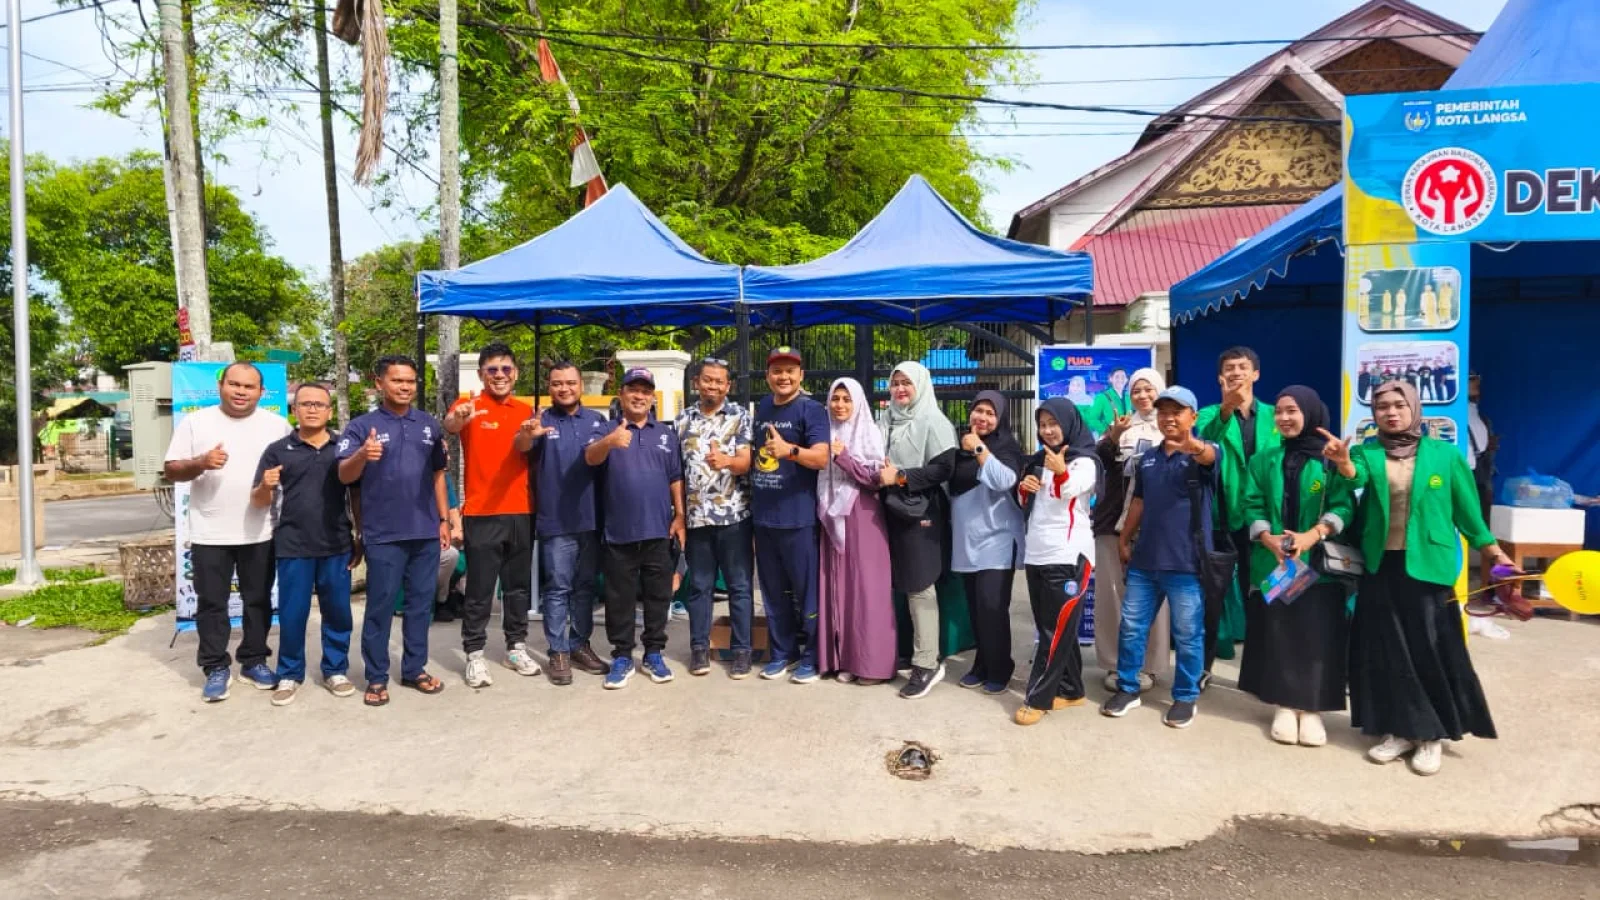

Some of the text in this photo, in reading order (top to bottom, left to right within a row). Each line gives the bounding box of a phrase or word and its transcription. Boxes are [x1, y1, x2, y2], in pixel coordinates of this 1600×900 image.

[1435, 99, 1520, 113] PEMERINTAH
[1435, 112, 1527, 126] KOTA LANGSA
[1415, 211, 1484, 232] KOTA LANGSA
[1067, 356, 1093, 366] FUAD
